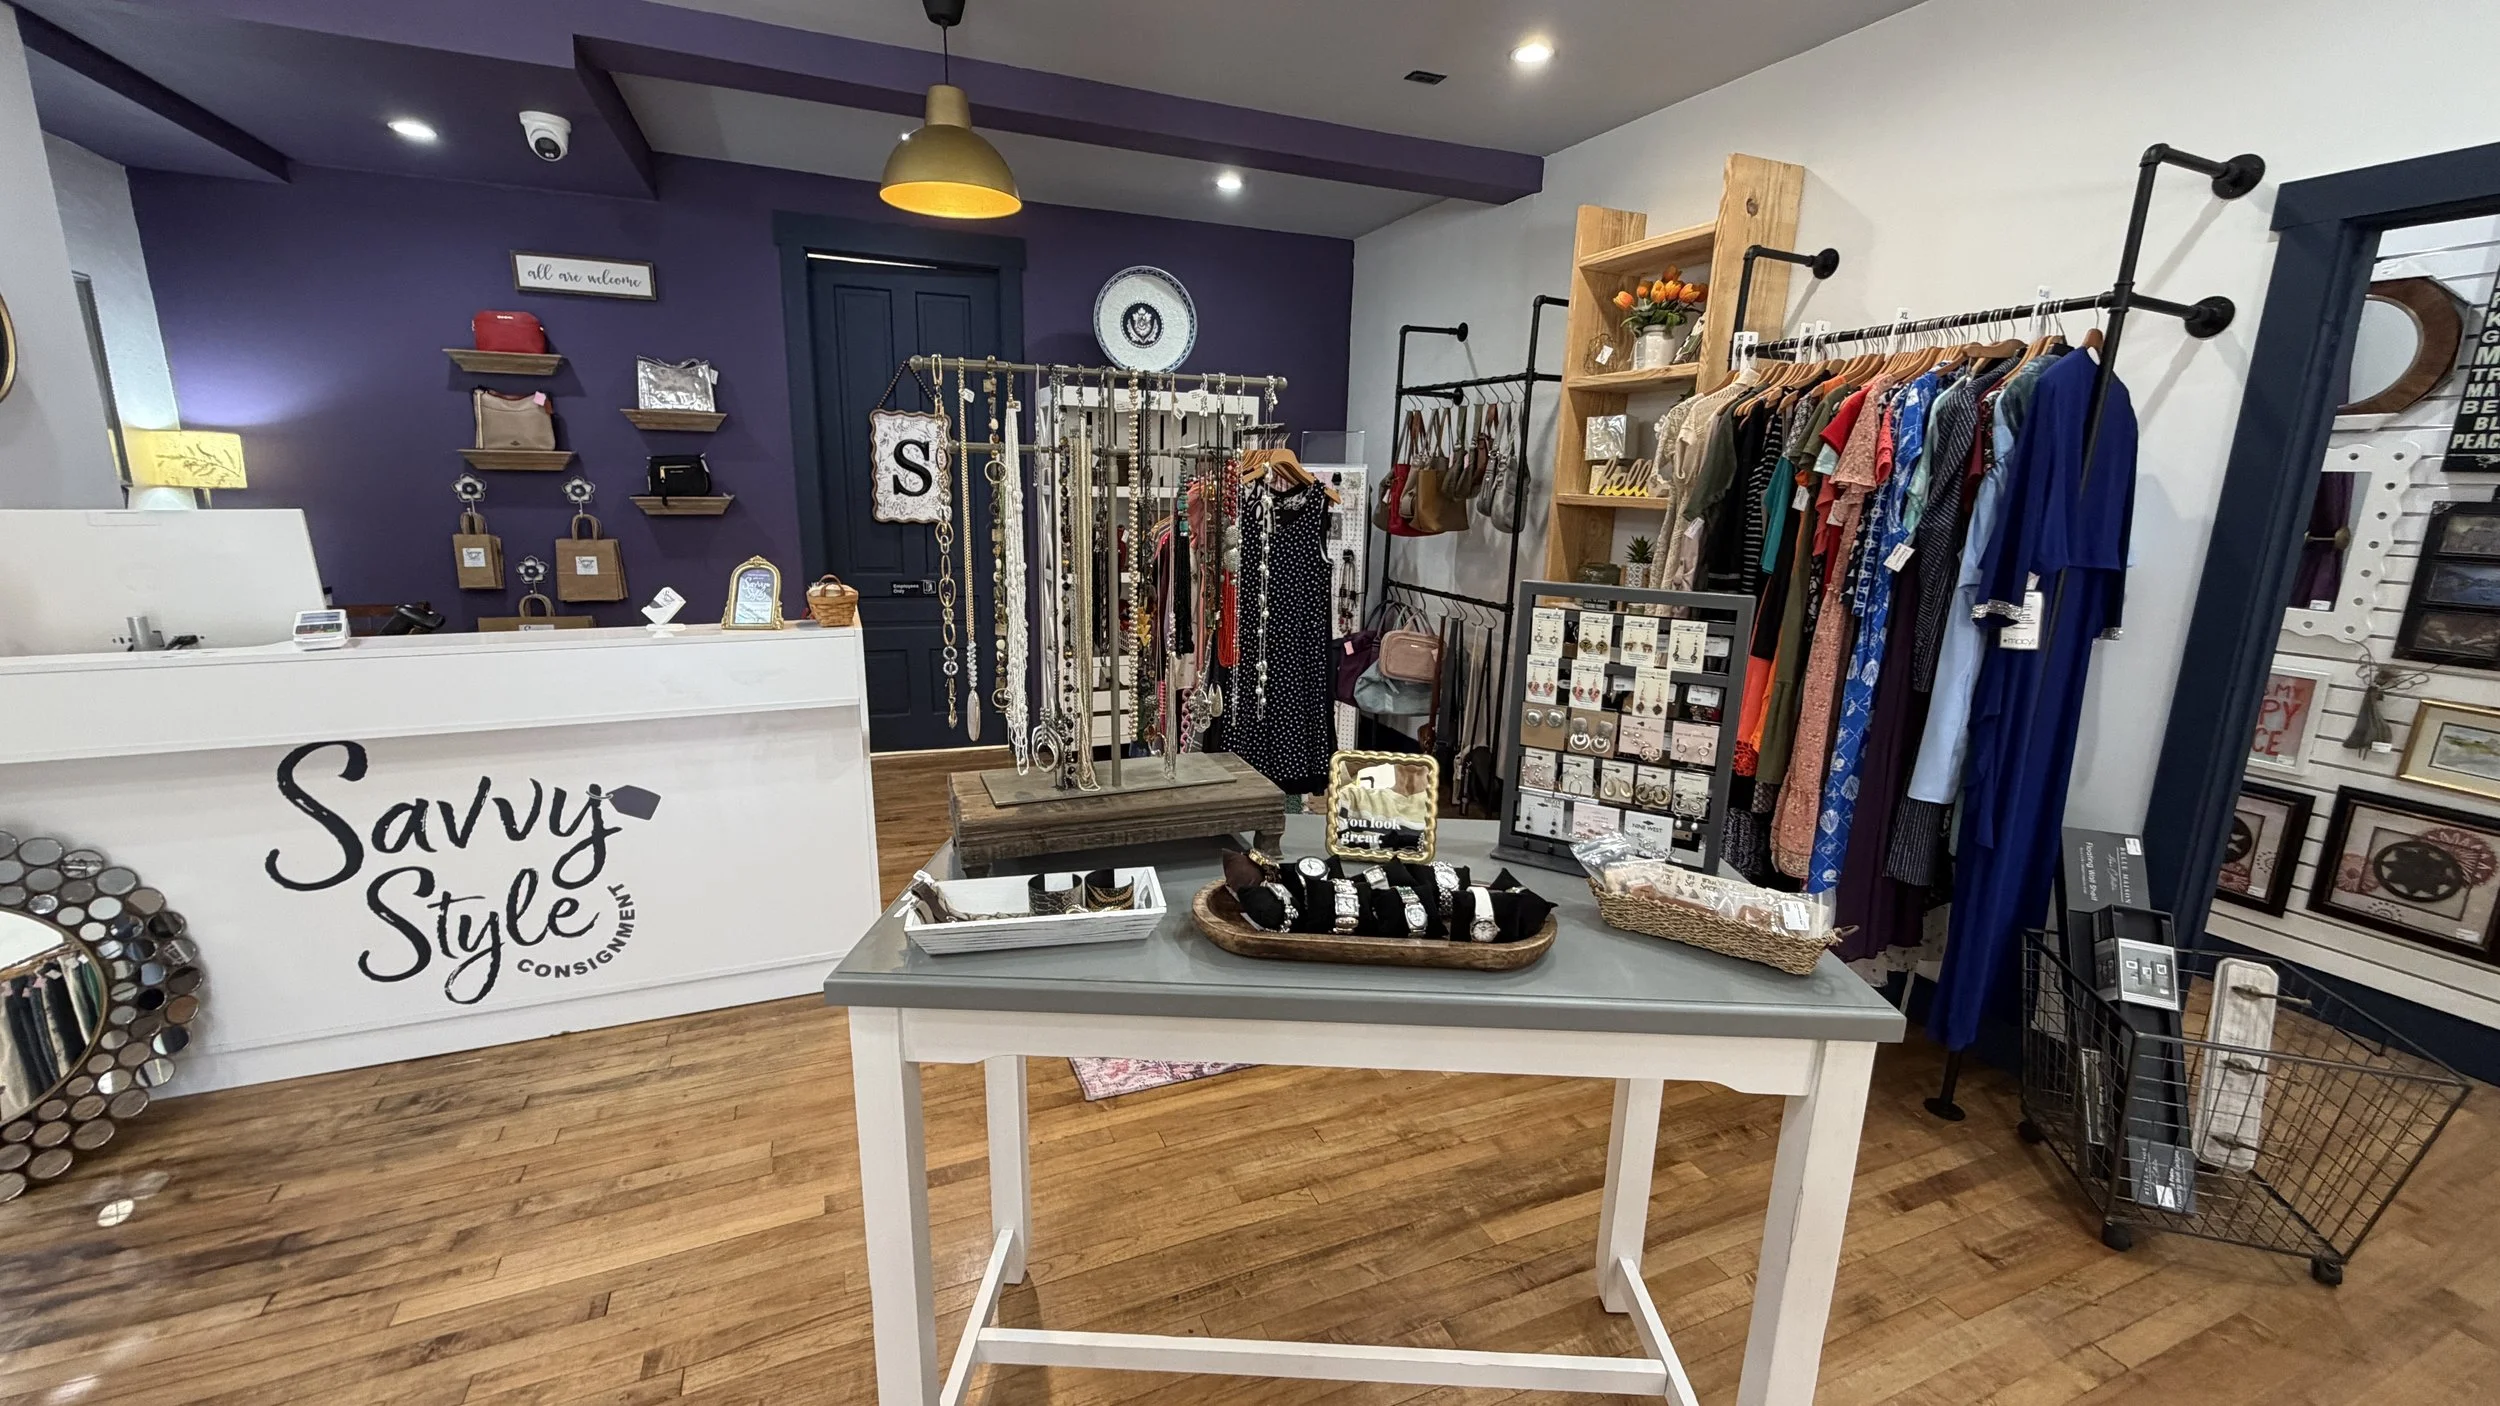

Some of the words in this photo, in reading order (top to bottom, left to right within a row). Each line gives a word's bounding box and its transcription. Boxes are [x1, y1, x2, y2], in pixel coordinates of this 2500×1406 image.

[527, 263, 553, 281] all
[558, 271, 582, 283] are
[587, 269, 642, 288] welcome
[2465, 382, 2500, 398] MA
[2450, 433, 2500, 449] PEAC
[893, 439, 932, 497] S
[1594, 457, 1653, 497] hell
[265, 740, 622, 891] Savvy
[1370, 817, 1401, 831] look
[358, 866, 600, 1004] Style
[517, 884, 636, 979] CONSIGNMENT
